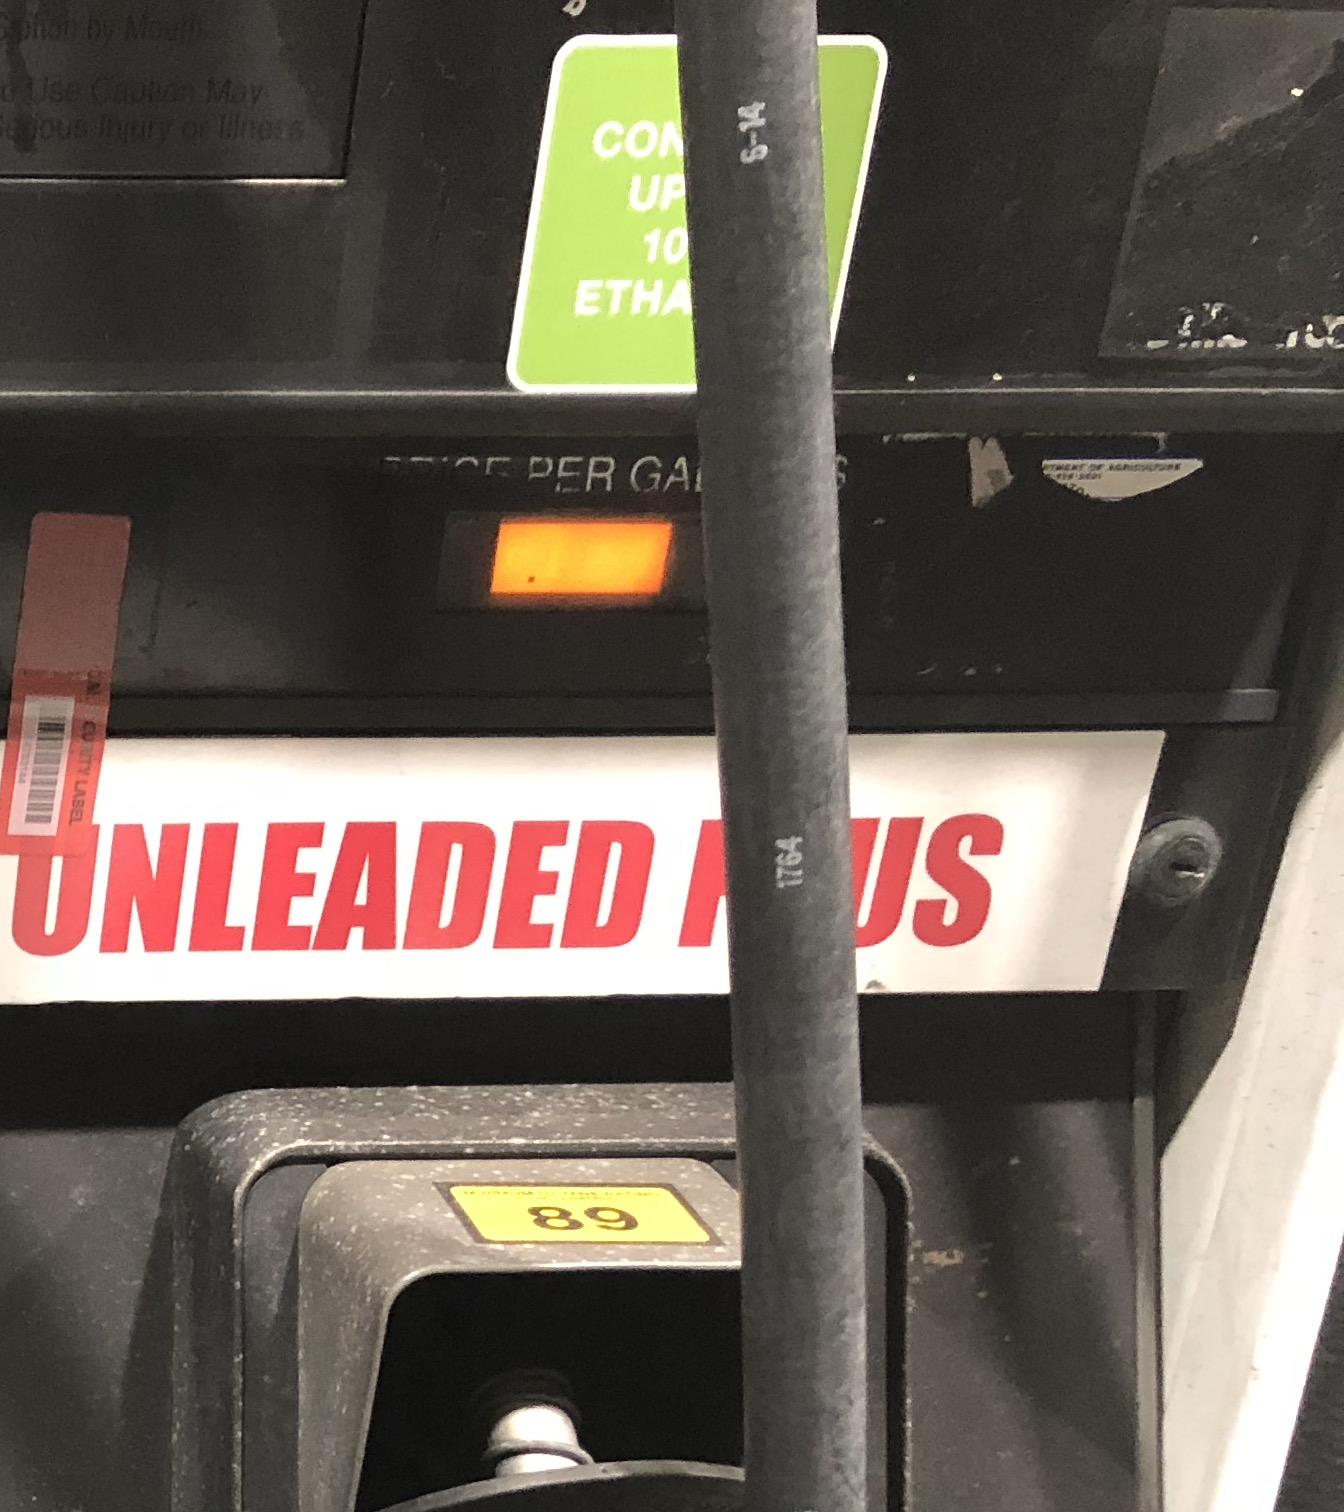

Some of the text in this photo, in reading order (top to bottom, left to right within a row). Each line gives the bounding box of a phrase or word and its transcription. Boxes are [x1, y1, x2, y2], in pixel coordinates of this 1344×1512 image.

[206, 78, 265, 106] May
[629, 175, 686, 212] UP
[643, 227, 689, 265] 10
[575, 279, 693, 317] ETHA
[528, 456, 616, 494] PER
[629, 456, 703, 493] GAL
[10, 820, 656, 957] UNLEADED
[527, 1206, 639, 1231] 89
